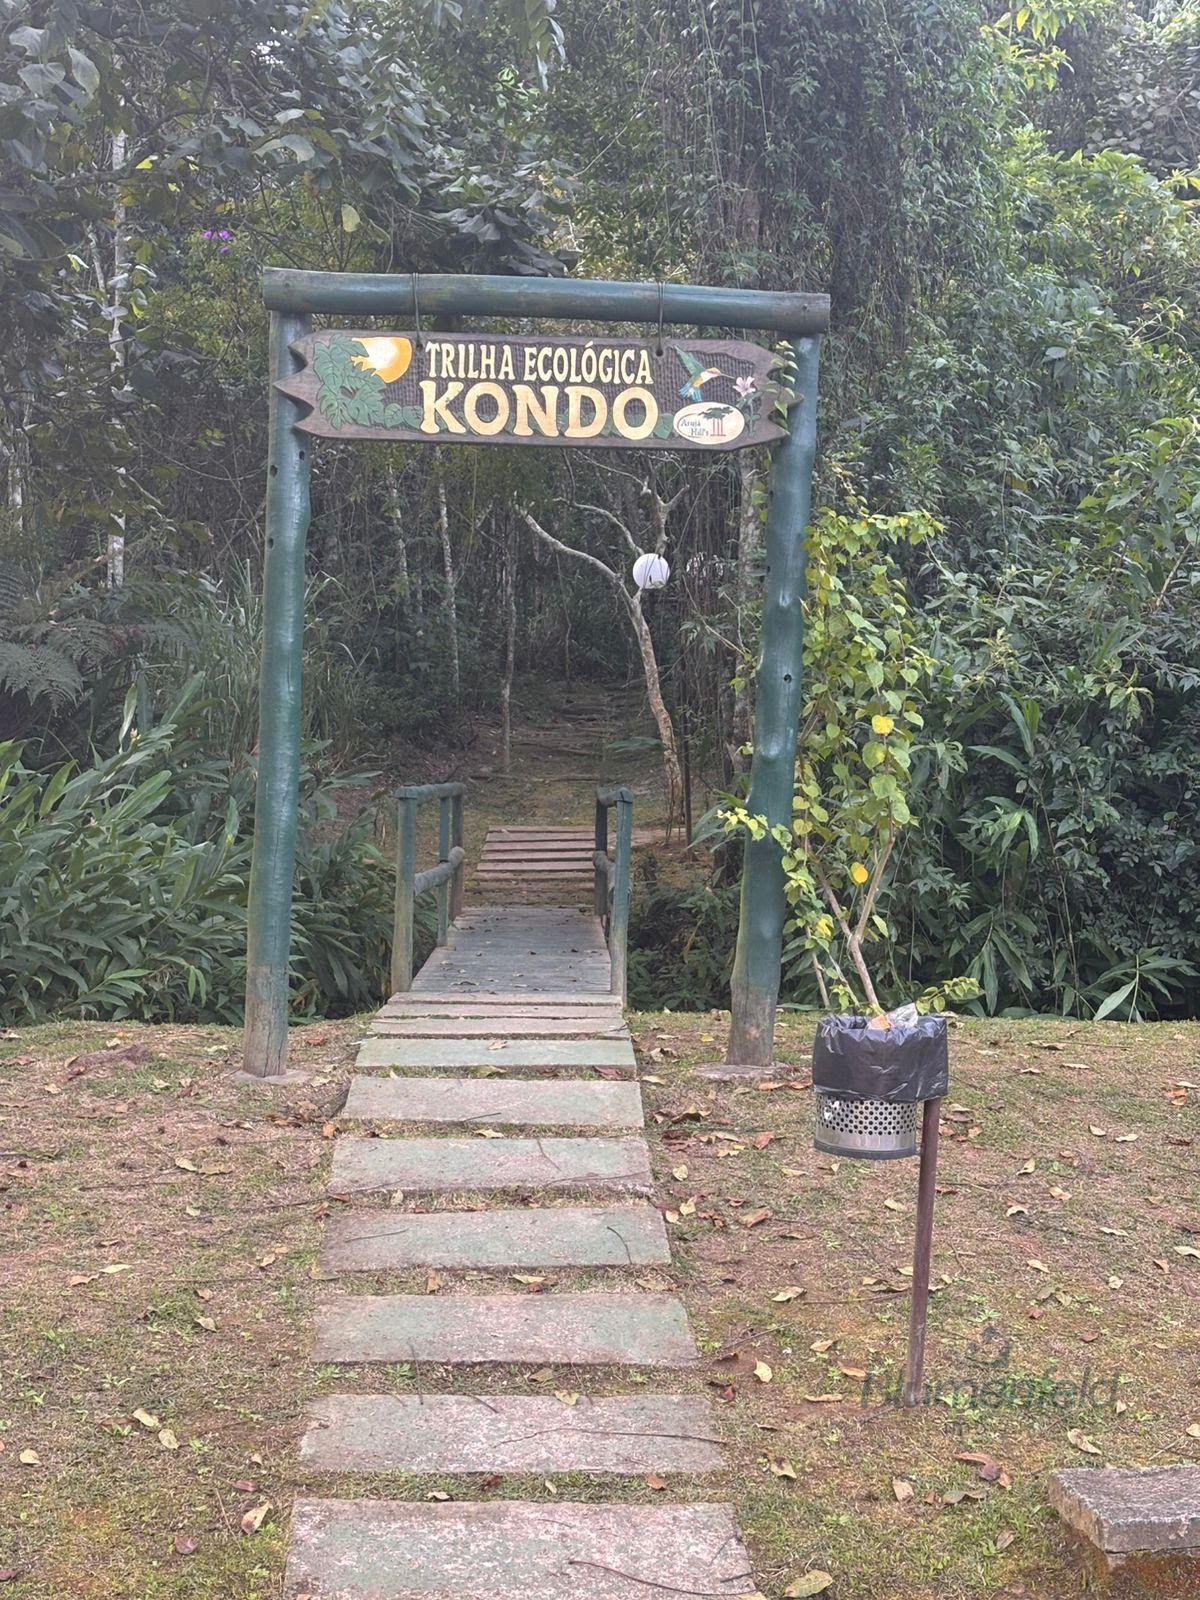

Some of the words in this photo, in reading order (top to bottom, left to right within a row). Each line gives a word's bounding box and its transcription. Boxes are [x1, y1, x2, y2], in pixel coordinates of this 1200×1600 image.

[424, 341, 516, 381] TRILHA
[523, 340, 655, 385] ECOLÓGICA
[418, 380, 659, 441] KONDO
